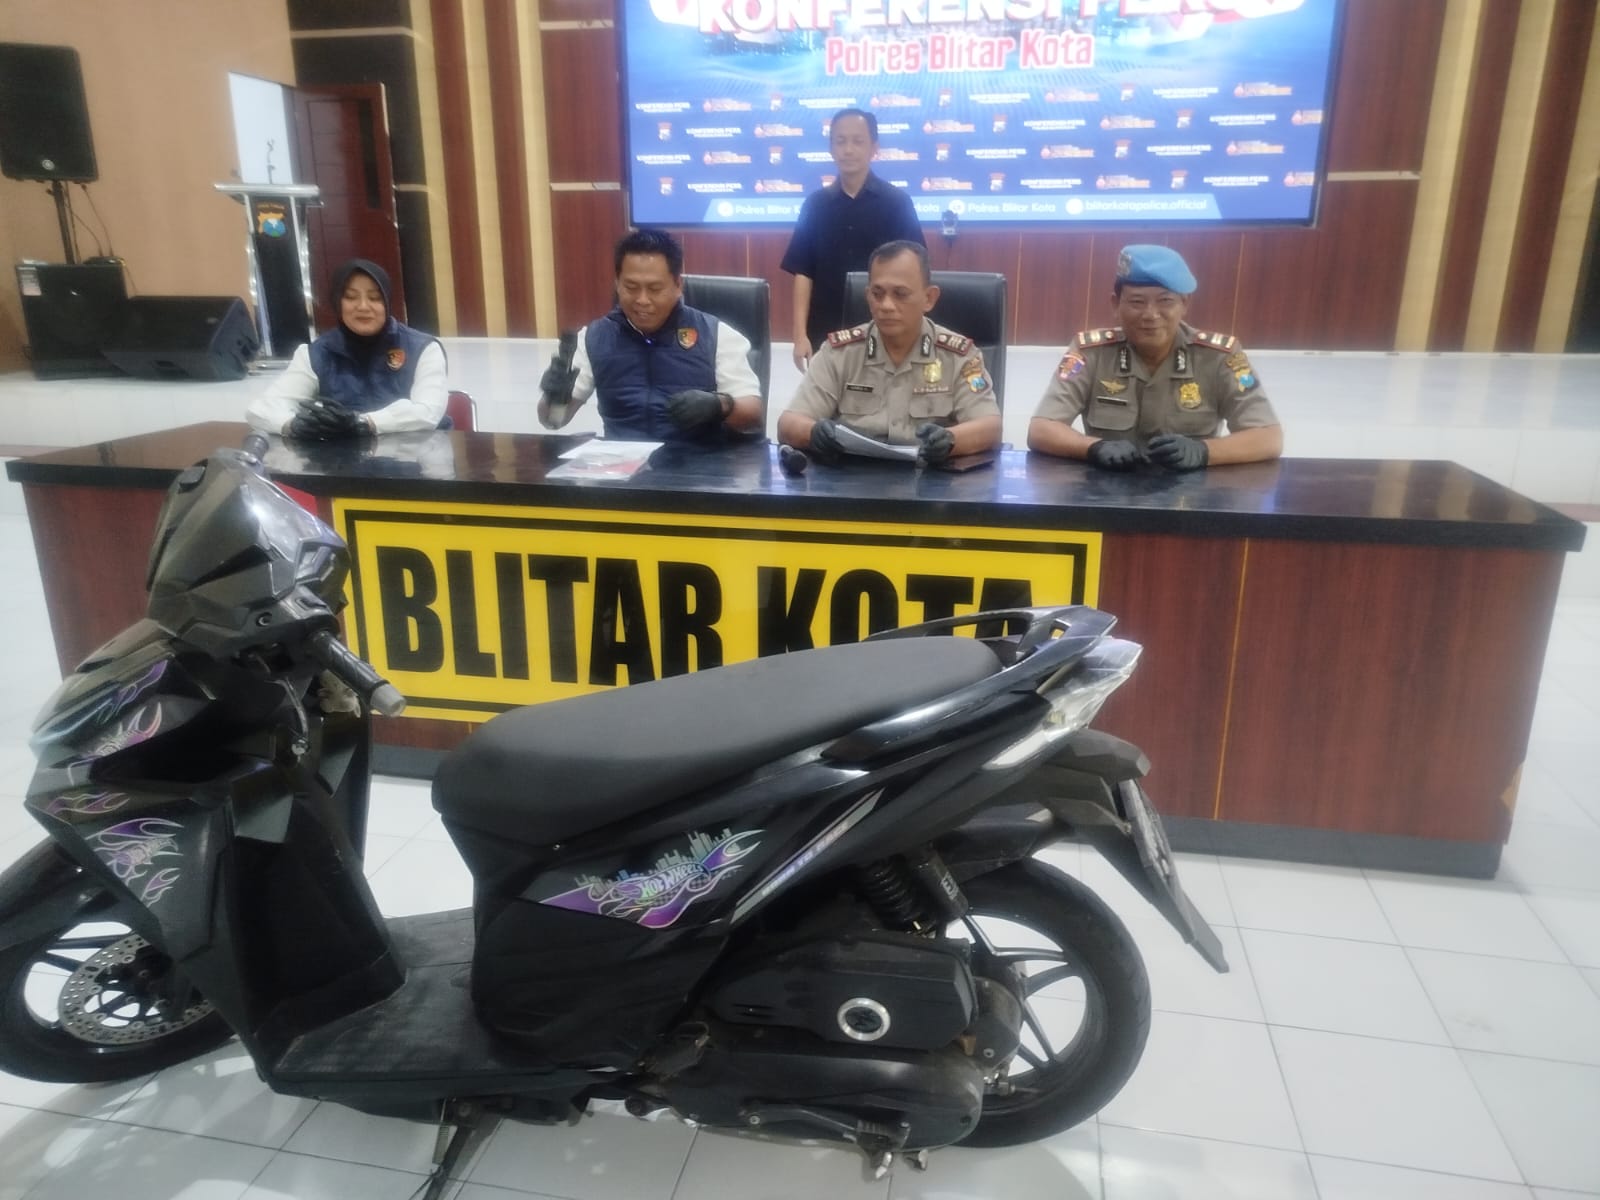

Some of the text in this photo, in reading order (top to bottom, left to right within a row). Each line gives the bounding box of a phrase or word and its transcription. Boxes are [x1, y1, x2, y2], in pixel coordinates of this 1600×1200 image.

[826, 29, 1094, 76] Polres Blitar Kota
[375, 545, 723, 686] BLITAR
